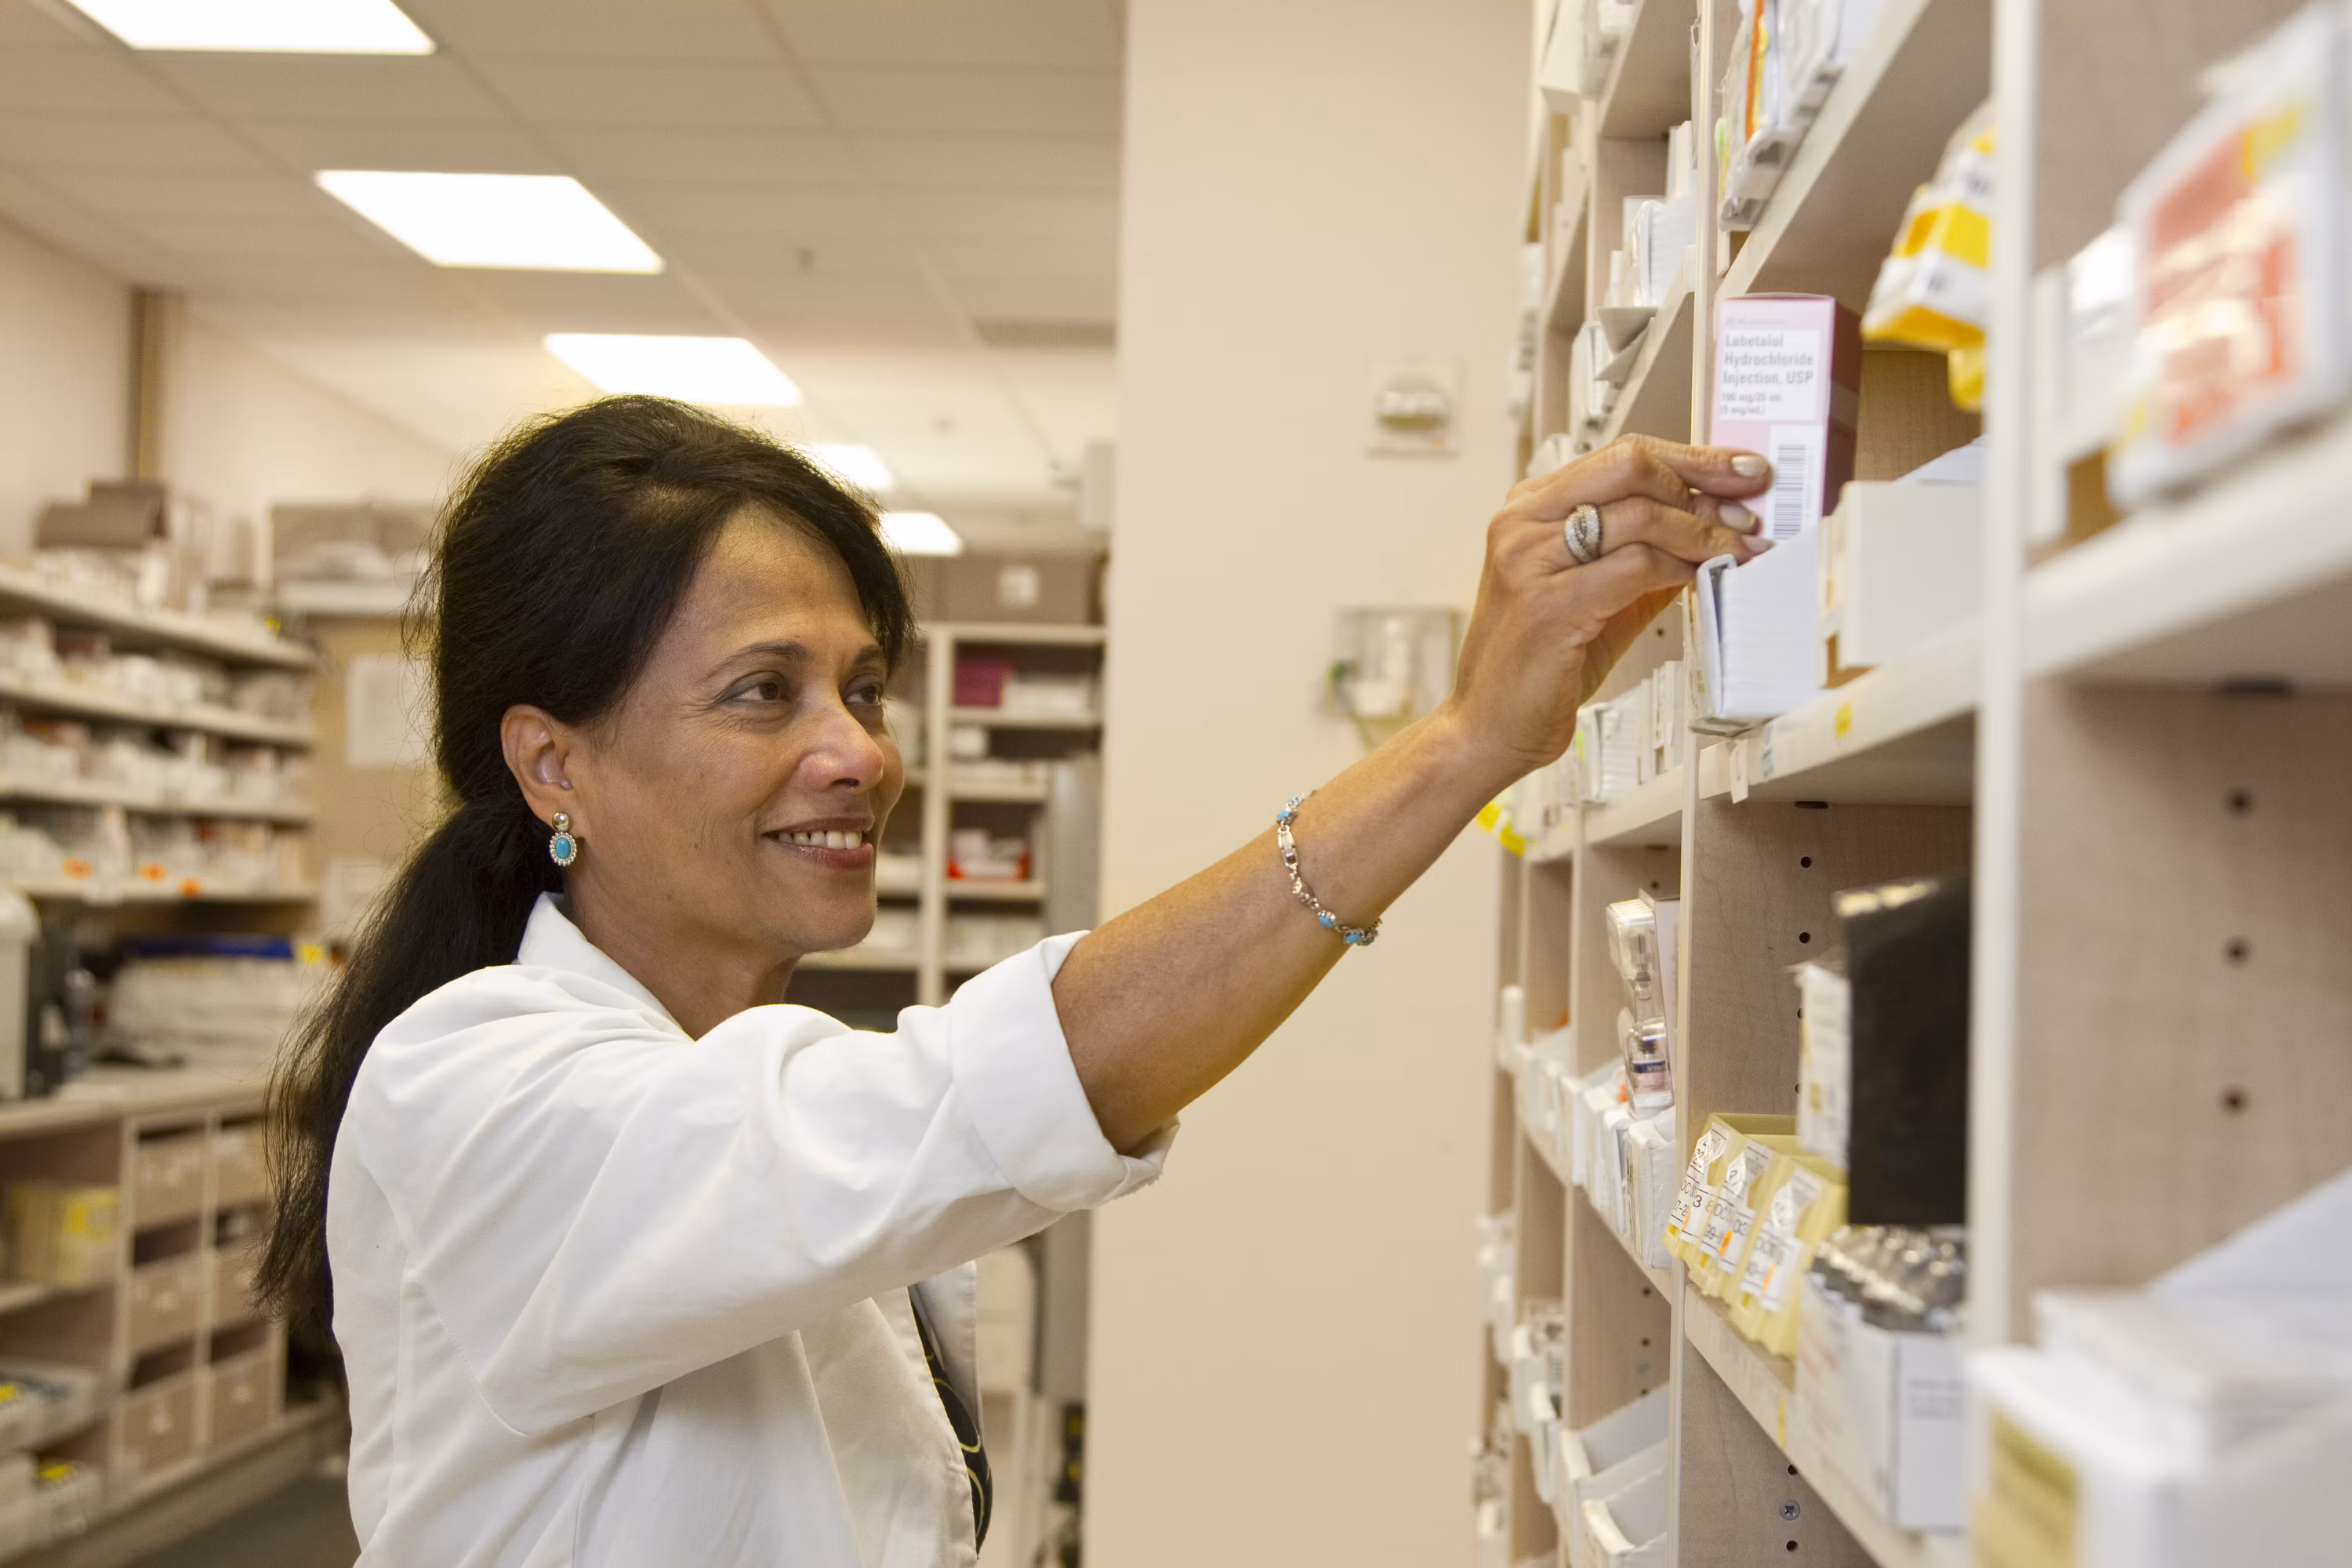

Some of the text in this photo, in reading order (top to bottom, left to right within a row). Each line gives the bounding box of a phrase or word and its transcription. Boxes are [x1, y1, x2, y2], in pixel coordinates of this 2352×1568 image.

[1726, 333, 1784, 347] Labetalol
[1725, 352, 1813, 368] Hydrochloride
[1787, 370, 1813, 384] USP
